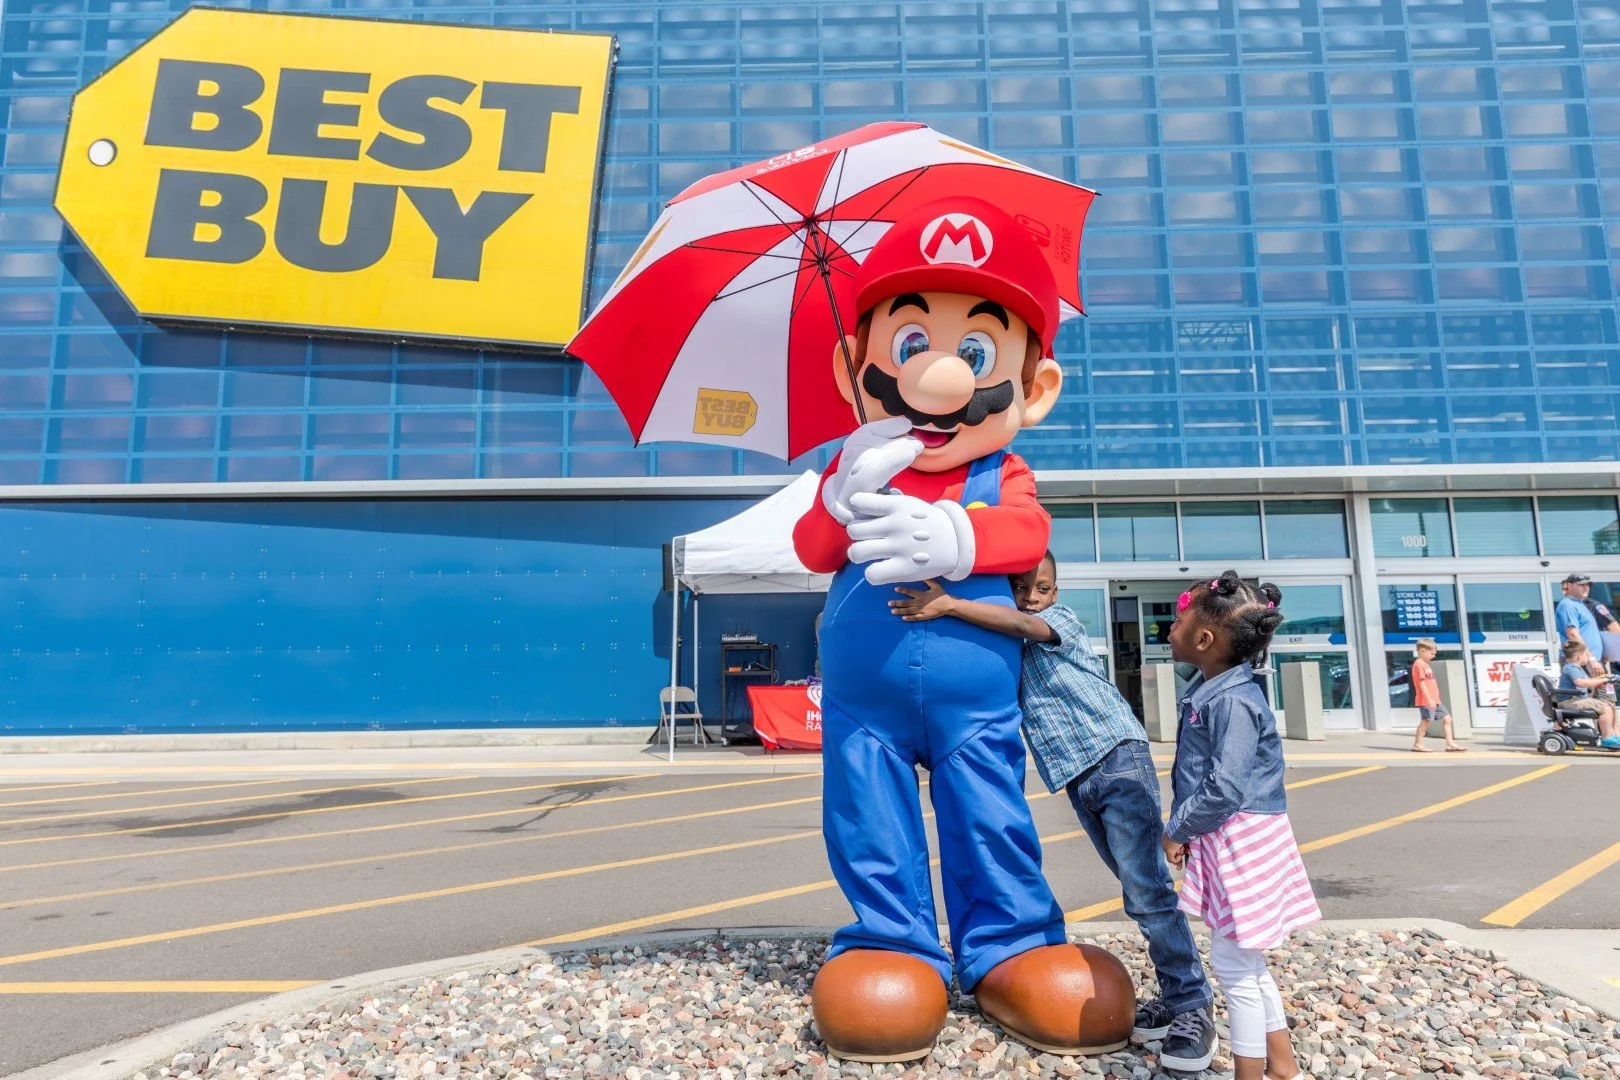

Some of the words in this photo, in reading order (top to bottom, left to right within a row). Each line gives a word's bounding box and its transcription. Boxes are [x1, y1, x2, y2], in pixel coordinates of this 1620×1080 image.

[144, 58, 582, 174] BEST
[145, 168, 535, 282] BUY
[924, 217, 987, 262] M
[1400, 534, 1427, 548] 1000
[1488, 672, 1512, 682] WA
